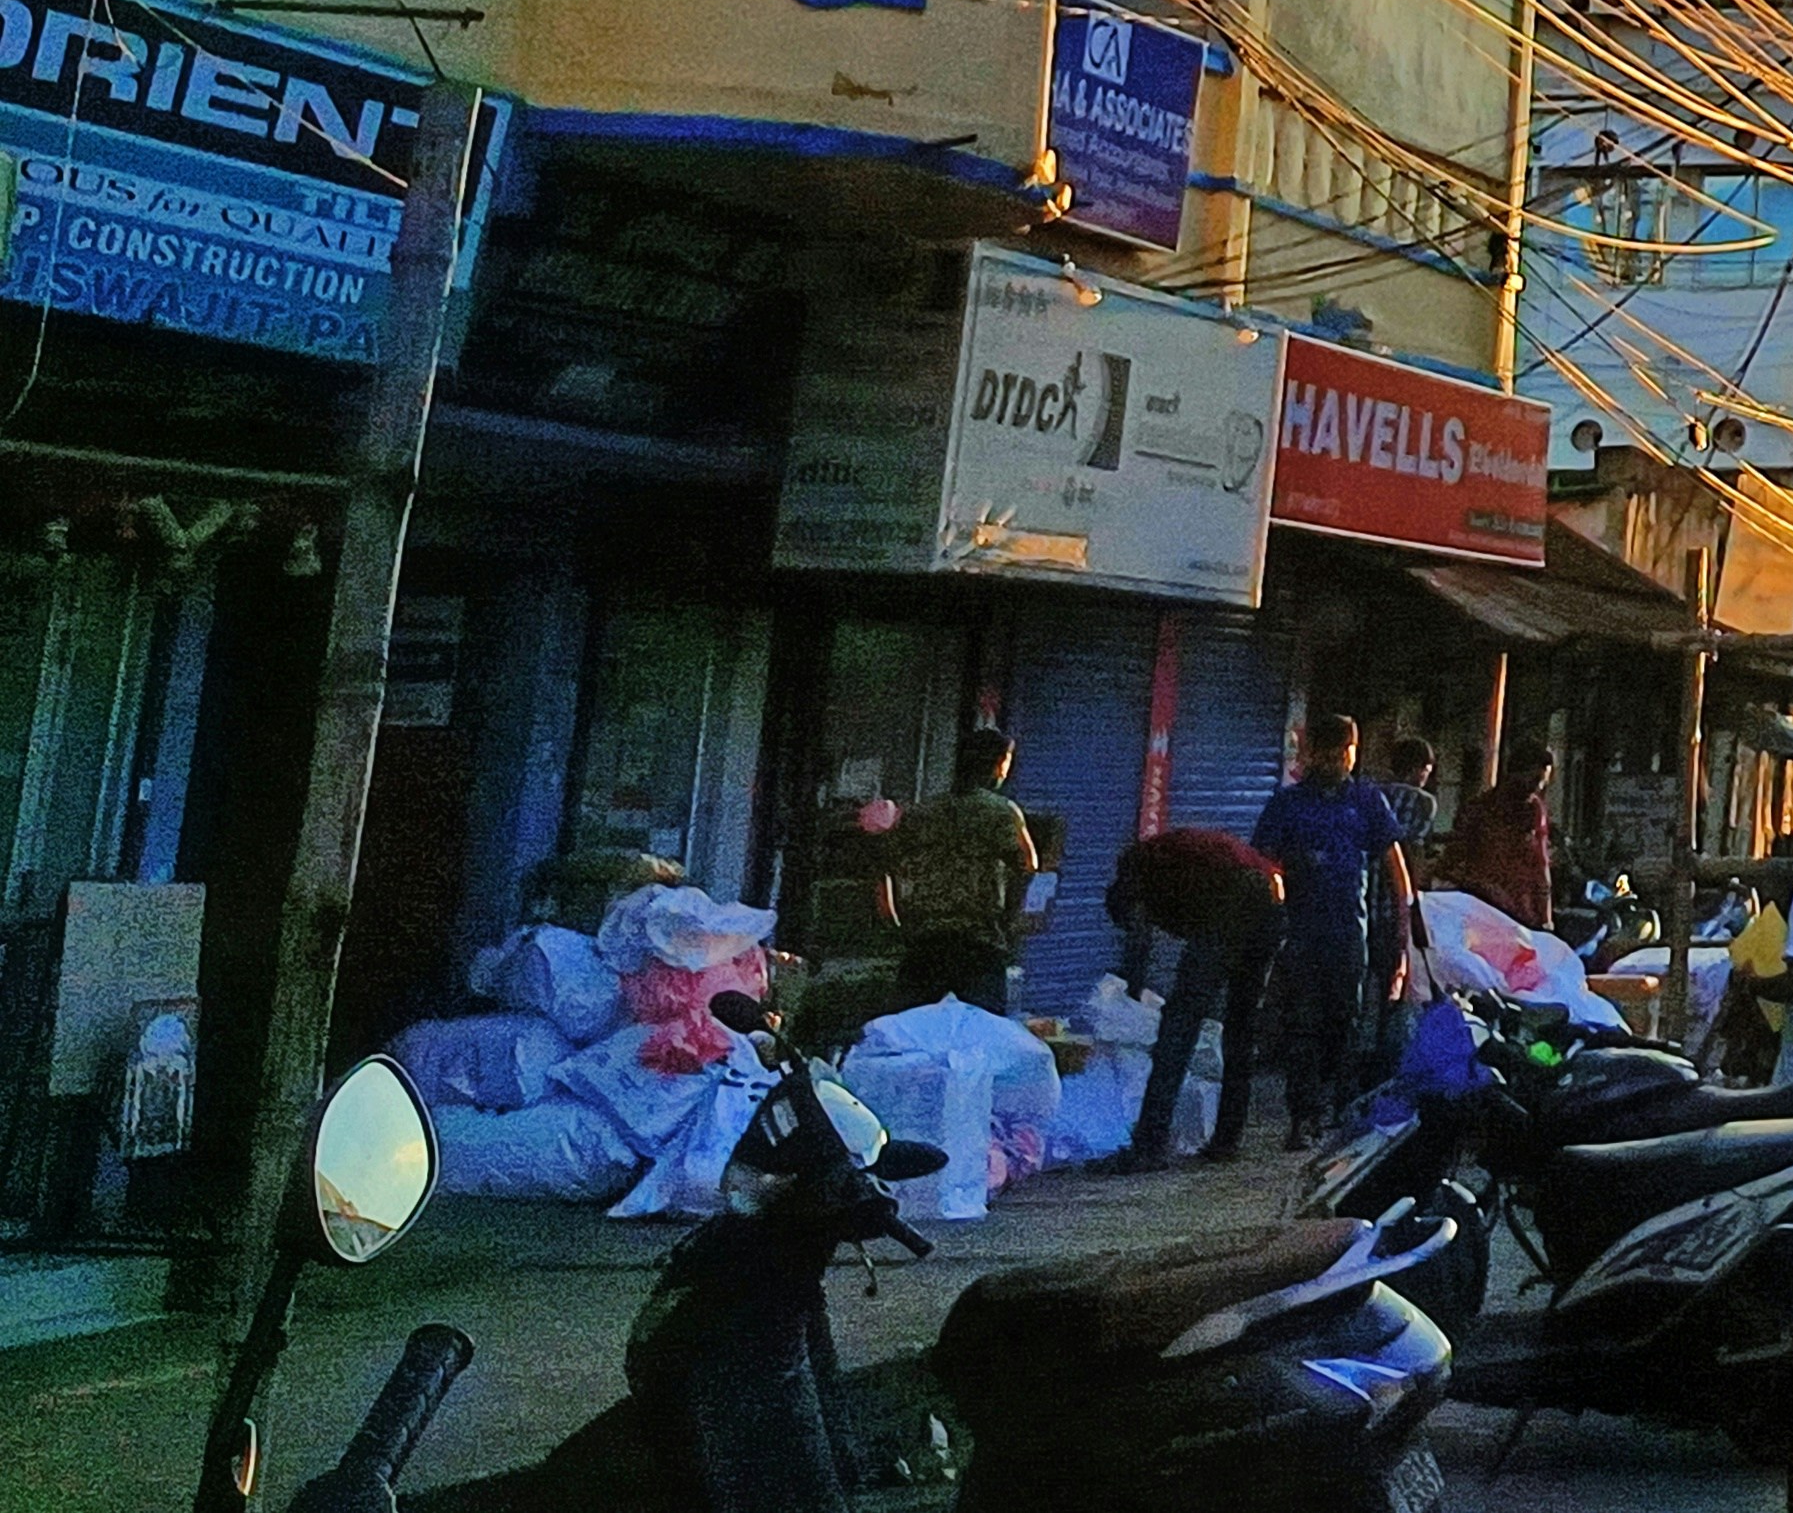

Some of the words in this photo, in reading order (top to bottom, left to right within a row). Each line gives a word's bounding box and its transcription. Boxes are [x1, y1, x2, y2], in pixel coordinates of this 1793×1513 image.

[1088, 86, 1196, 155] ASSOCIATES
[20, 157, 136, 203] OUS
[146, 186, 200, 219] for
[4, 251, 282, 339] ISWAJIT
[67, 217, 365, 305] CONSTRUCTION
[1281, 378, 1465, 485] HAVELLS
